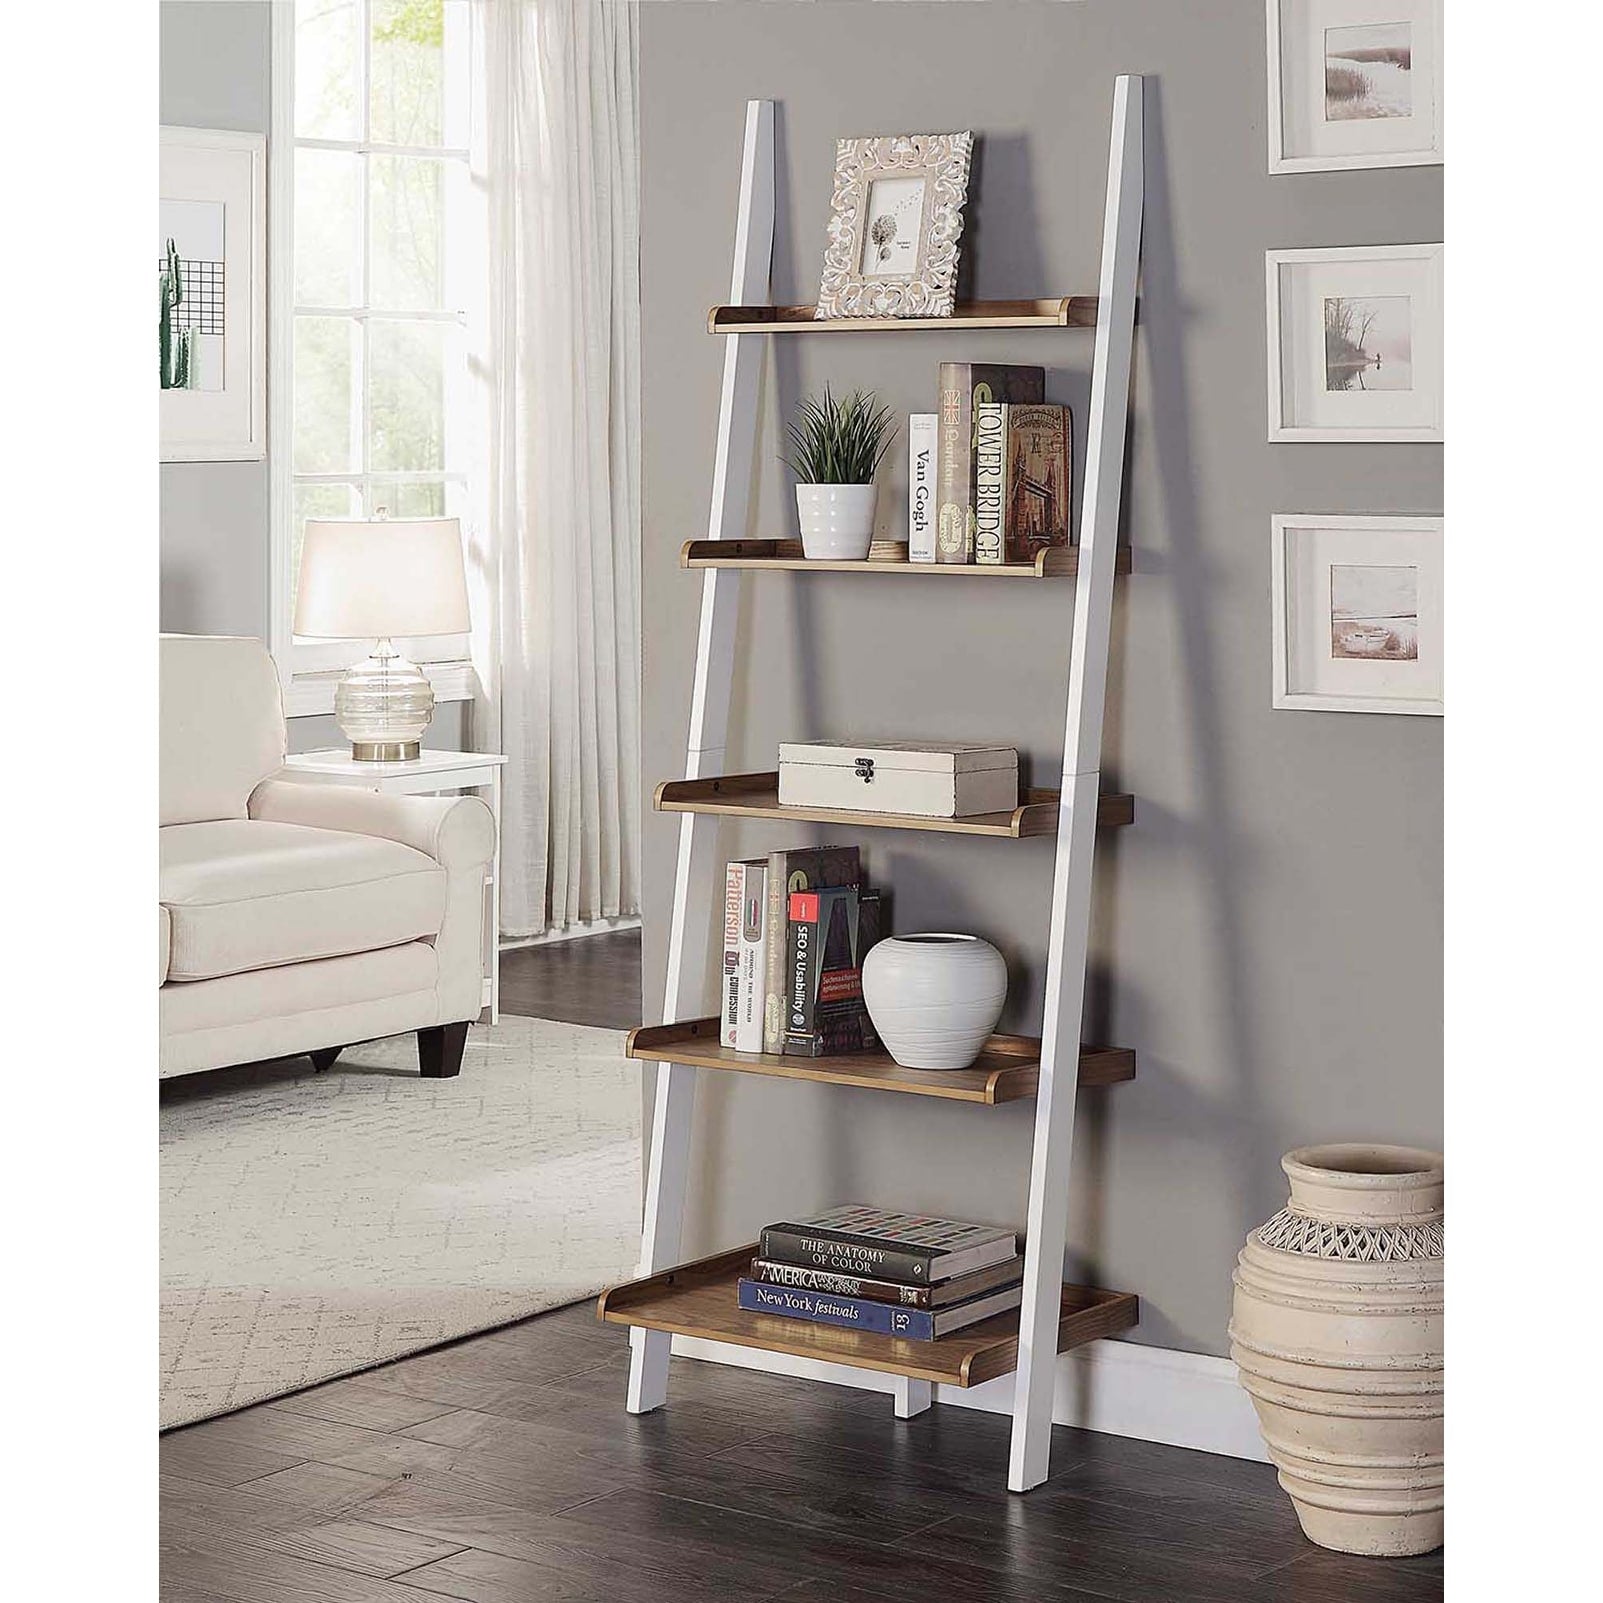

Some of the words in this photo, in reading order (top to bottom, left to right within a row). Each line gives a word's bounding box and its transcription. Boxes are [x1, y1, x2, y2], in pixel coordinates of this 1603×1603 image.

[977, 403, 1003, 477] TOWER
[916, 449, 930, 482] Van
[944, 430, 959, 486] London
[912, 485, 930, 532] Gogh
[976, 483, 1002, 560] BRIDGE
[727, 867, 744, 946] Patterson
[796, 925, 809, 948] SEO
[795, 949, 808, 960] &
[791, 960, 808, 1013] Usability
[800, 1239, 825, 1253] THE
[826, 1244, 886, 1263] ANATOMY
[812, 1253, 829, 1265] OF
[830, 1256, 872, 1273] COLOR
[760, 1265, 819, 1289] AMERICA
[756, 1289, 784, 1306] New
[784, 1293, 813, 1311] York
[812, 1300, 860, 1319] festivals
[895, 1313, 910, 1330] 13
